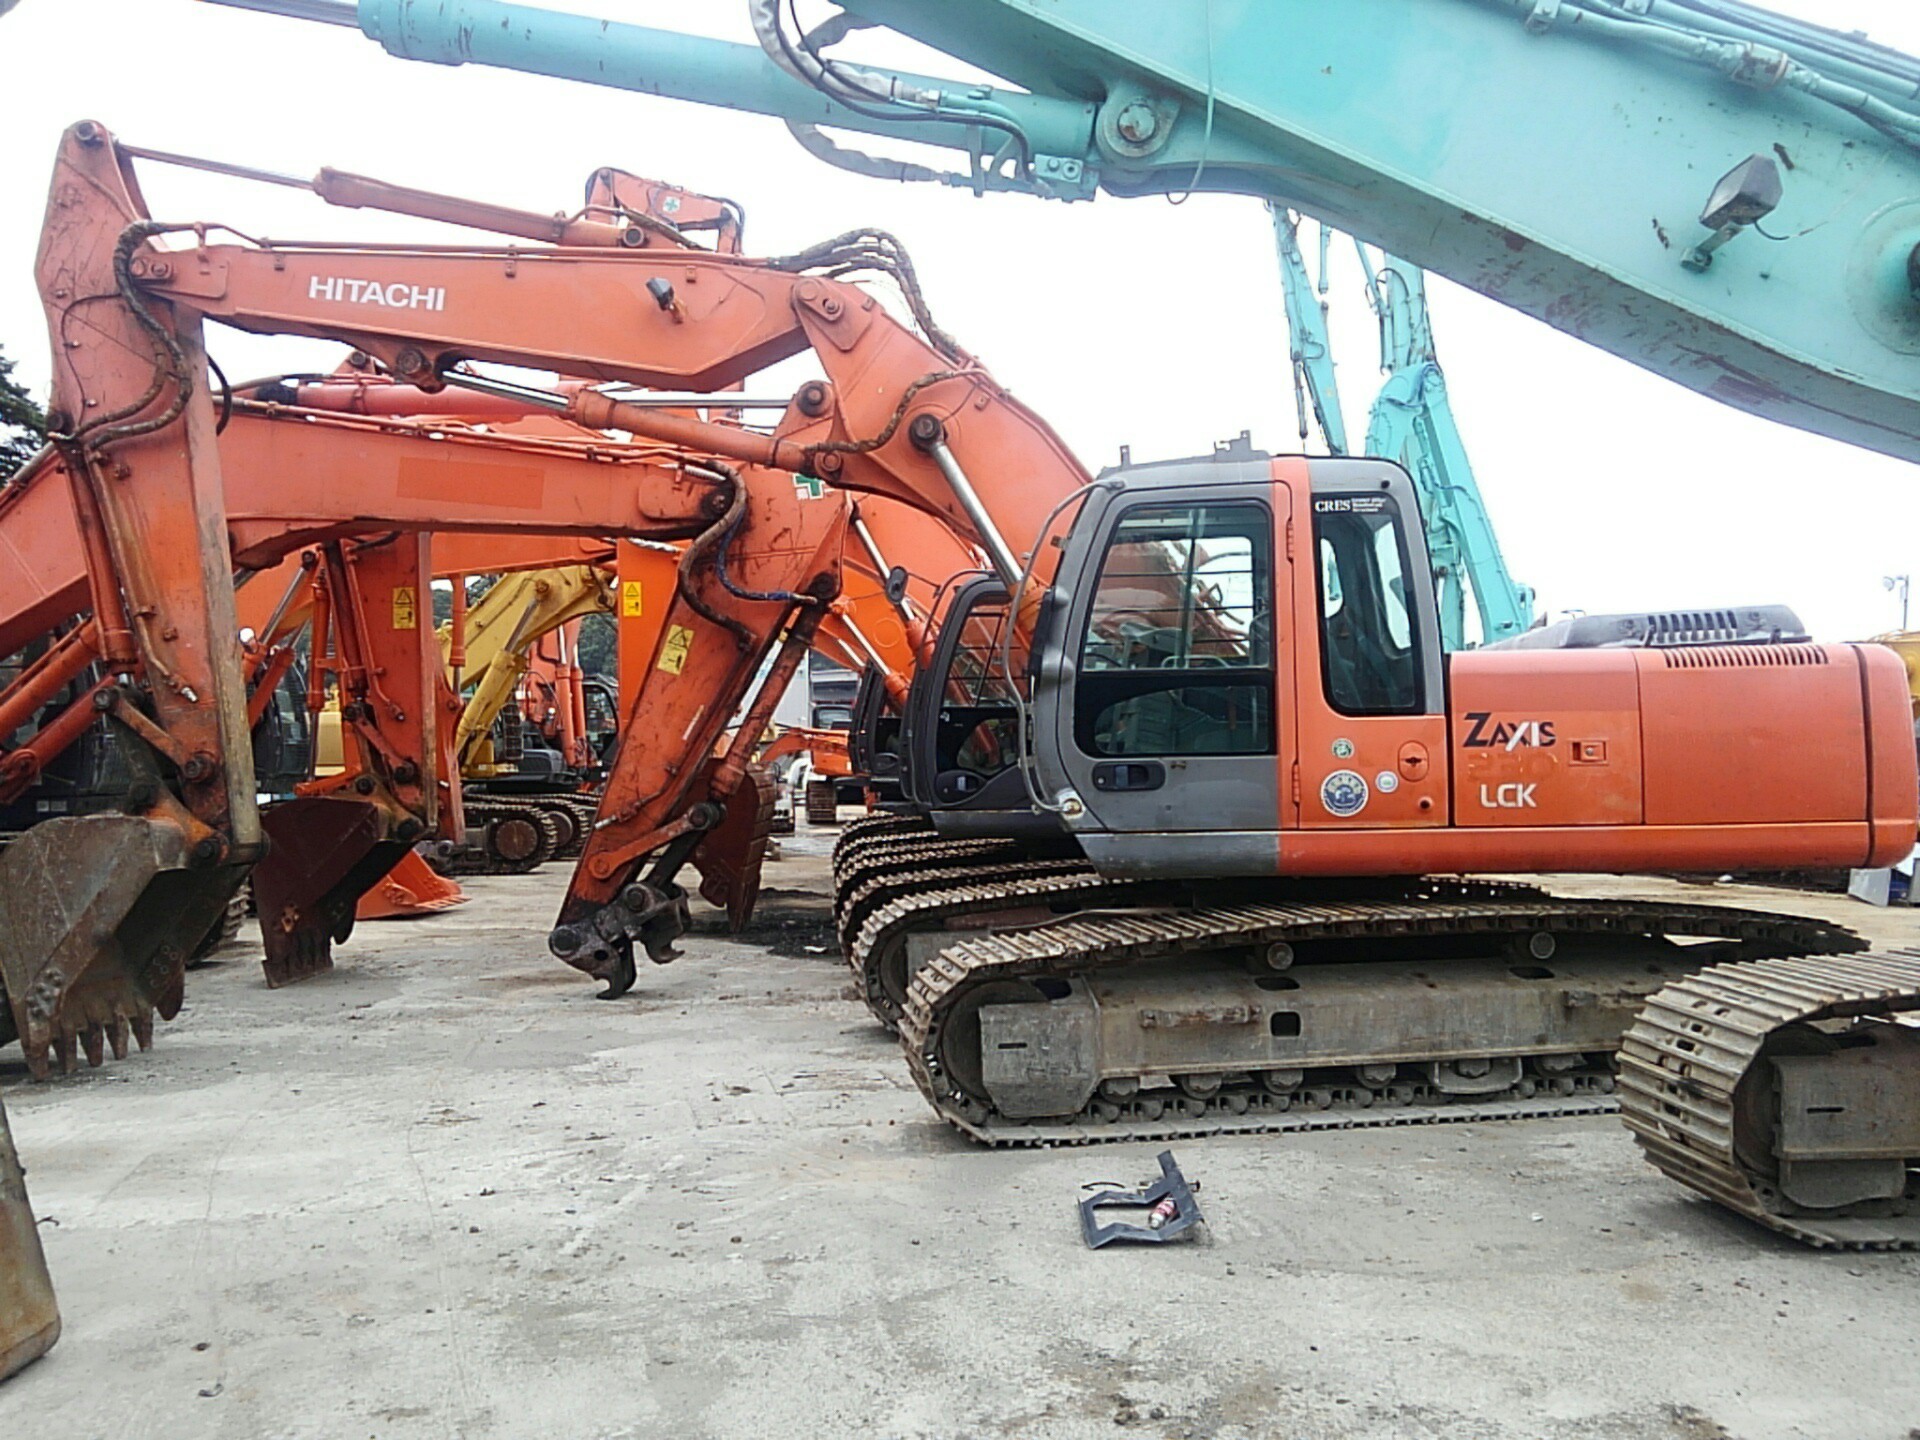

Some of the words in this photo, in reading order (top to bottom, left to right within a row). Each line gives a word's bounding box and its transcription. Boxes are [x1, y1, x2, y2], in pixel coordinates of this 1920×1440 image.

[309, 276, 445, 311] HITACHI
[1315, 499, 1351, 512] CRES
[1480, 783, 1537, 808] LCK
